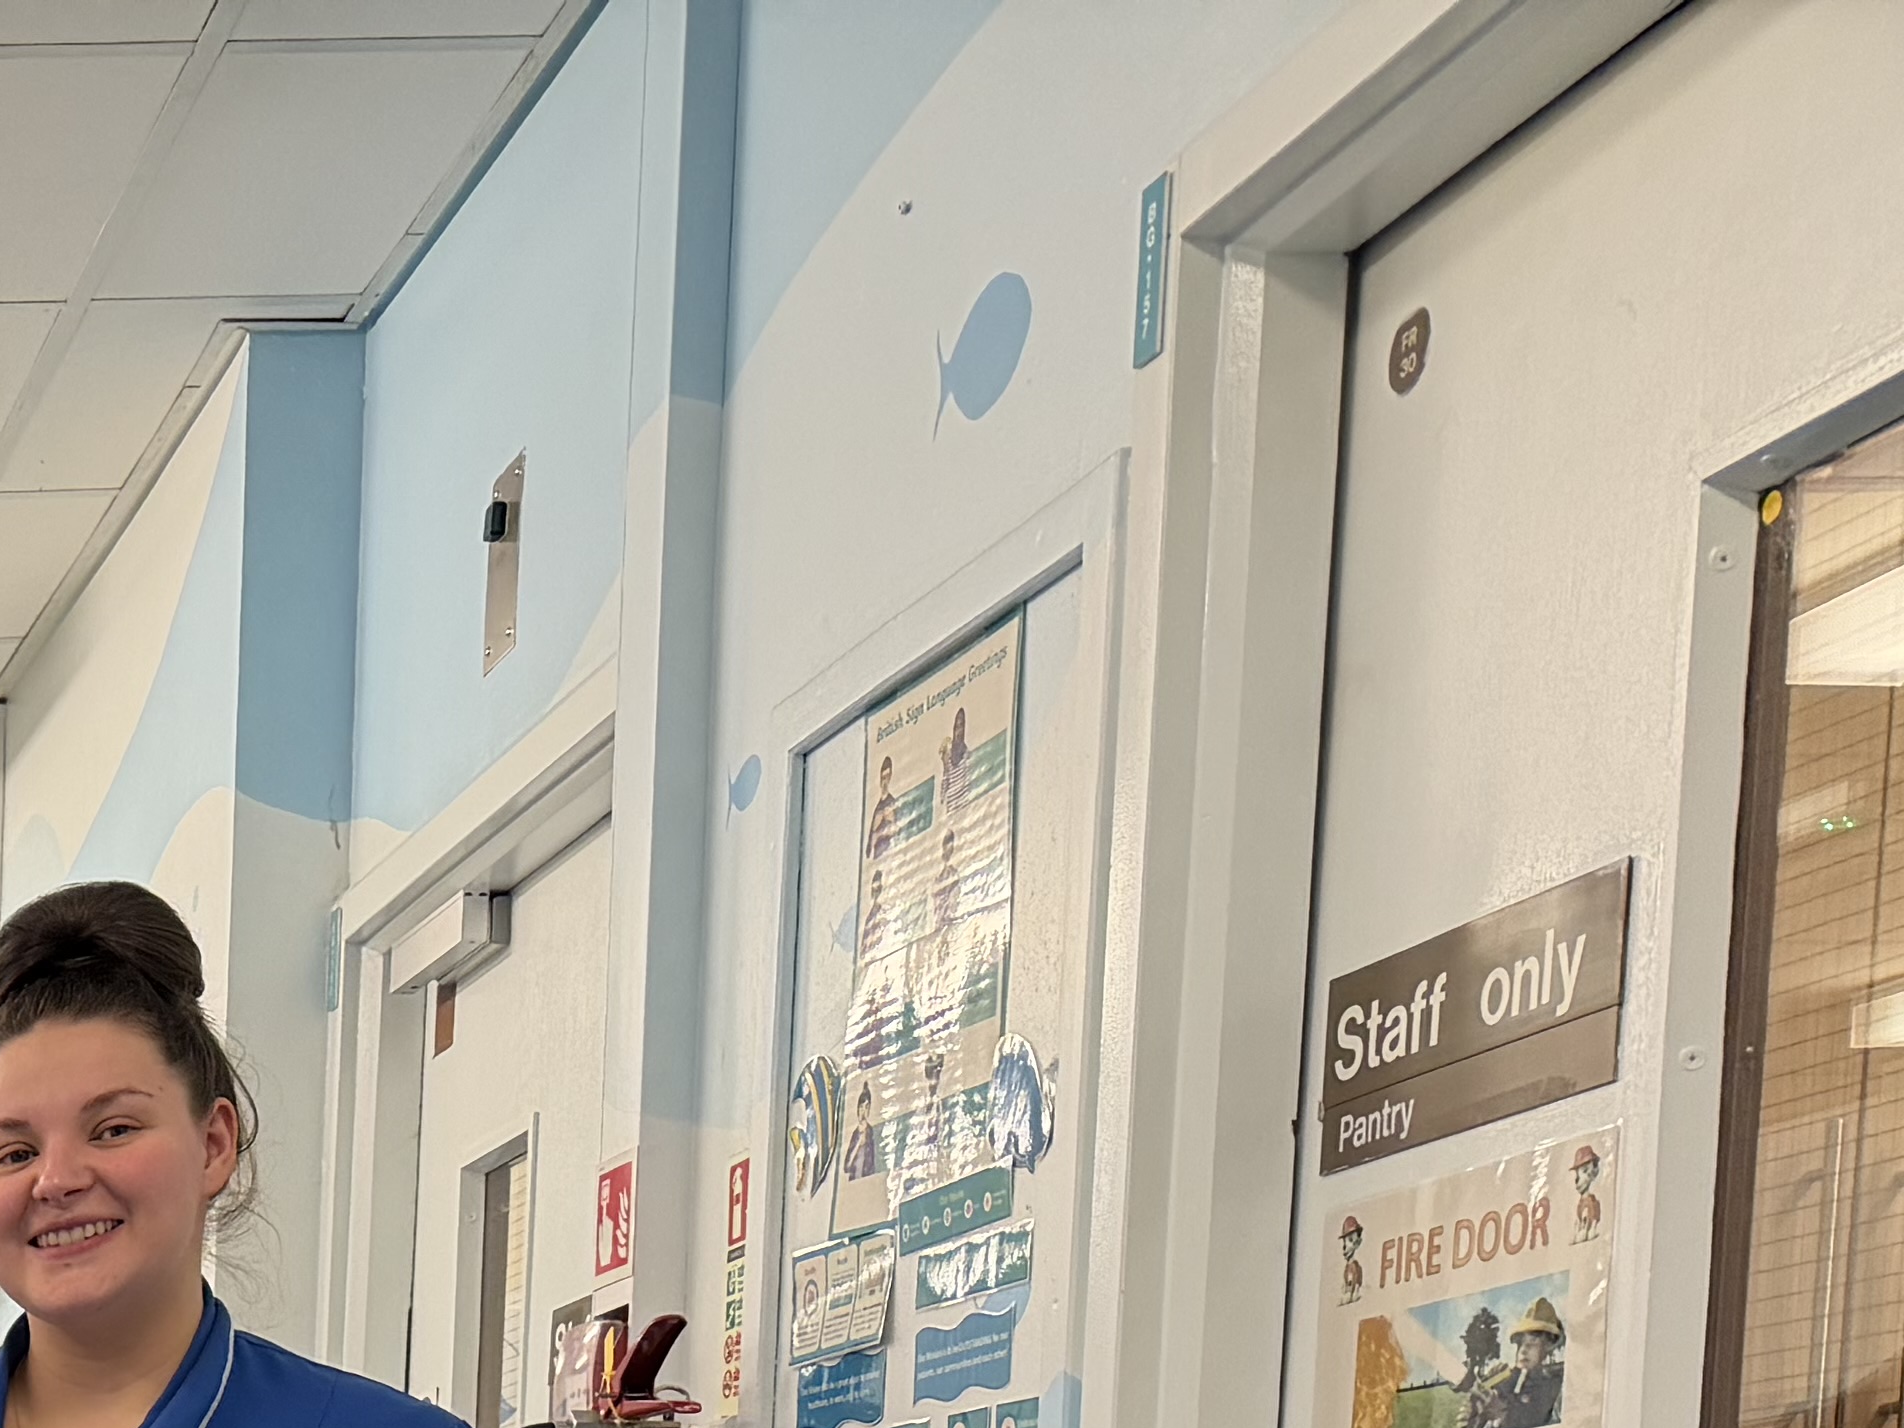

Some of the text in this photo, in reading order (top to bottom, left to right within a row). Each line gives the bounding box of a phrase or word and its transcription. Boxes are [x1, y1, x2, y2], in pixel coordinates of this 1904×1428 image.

[1399, 352, 1417, 378] 30
[1334, 929, 1587, 1082] Staff only
[1337, 1098, 1415, 1154] Pantry
[1378, 1197, 1552, 1290] FIRE DOOR
